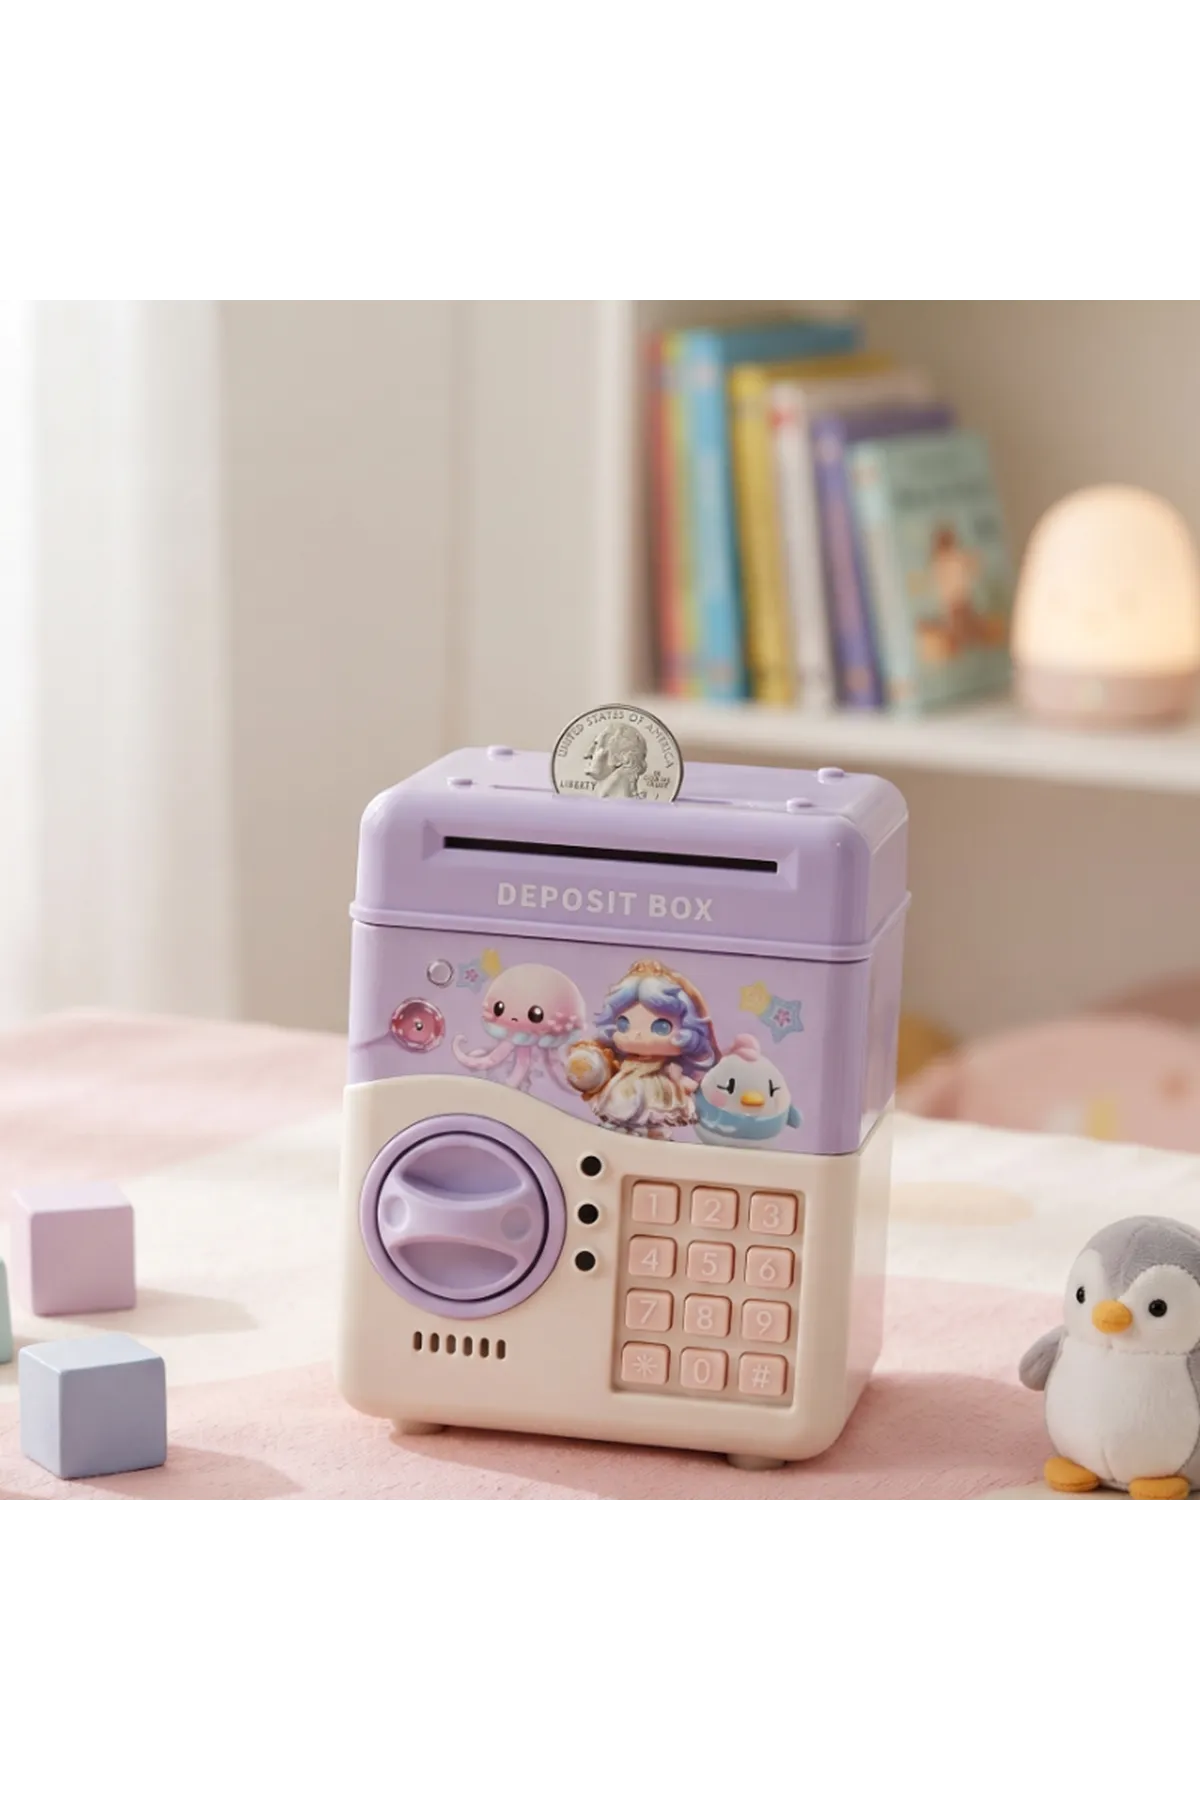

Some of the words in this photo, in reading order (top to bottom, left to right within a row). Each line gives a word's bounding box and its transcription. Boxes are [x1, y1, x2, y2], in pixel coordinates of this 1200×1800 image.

[558, 723, 584, 757] UNITED
[586, 711, 624, 727] STATES
[629, 713, 644, 725] OF
[559, 780, 597, 791] LIBERTY
[497, 882, 637, 916] DEPOSIT
[648, 894, 713, 922] BOX
[648, 1193, 659, 1217] 1
[704, 1198, 721, 1223] 2
[763, 1203, 780, 1229] 3
[641, 1247, 659, 1271] 4
[701, 1252, 717, 1277] 5
[759, 1257, 776, 1281] 6
[640, 1299, 657, 1324] 7
[696, 1305, 713, 1330] 8
[756, 1310, 772, 1336] 9
[693, 1358, 710, 1384] 0
[751, 1364, 771, 1389] #
